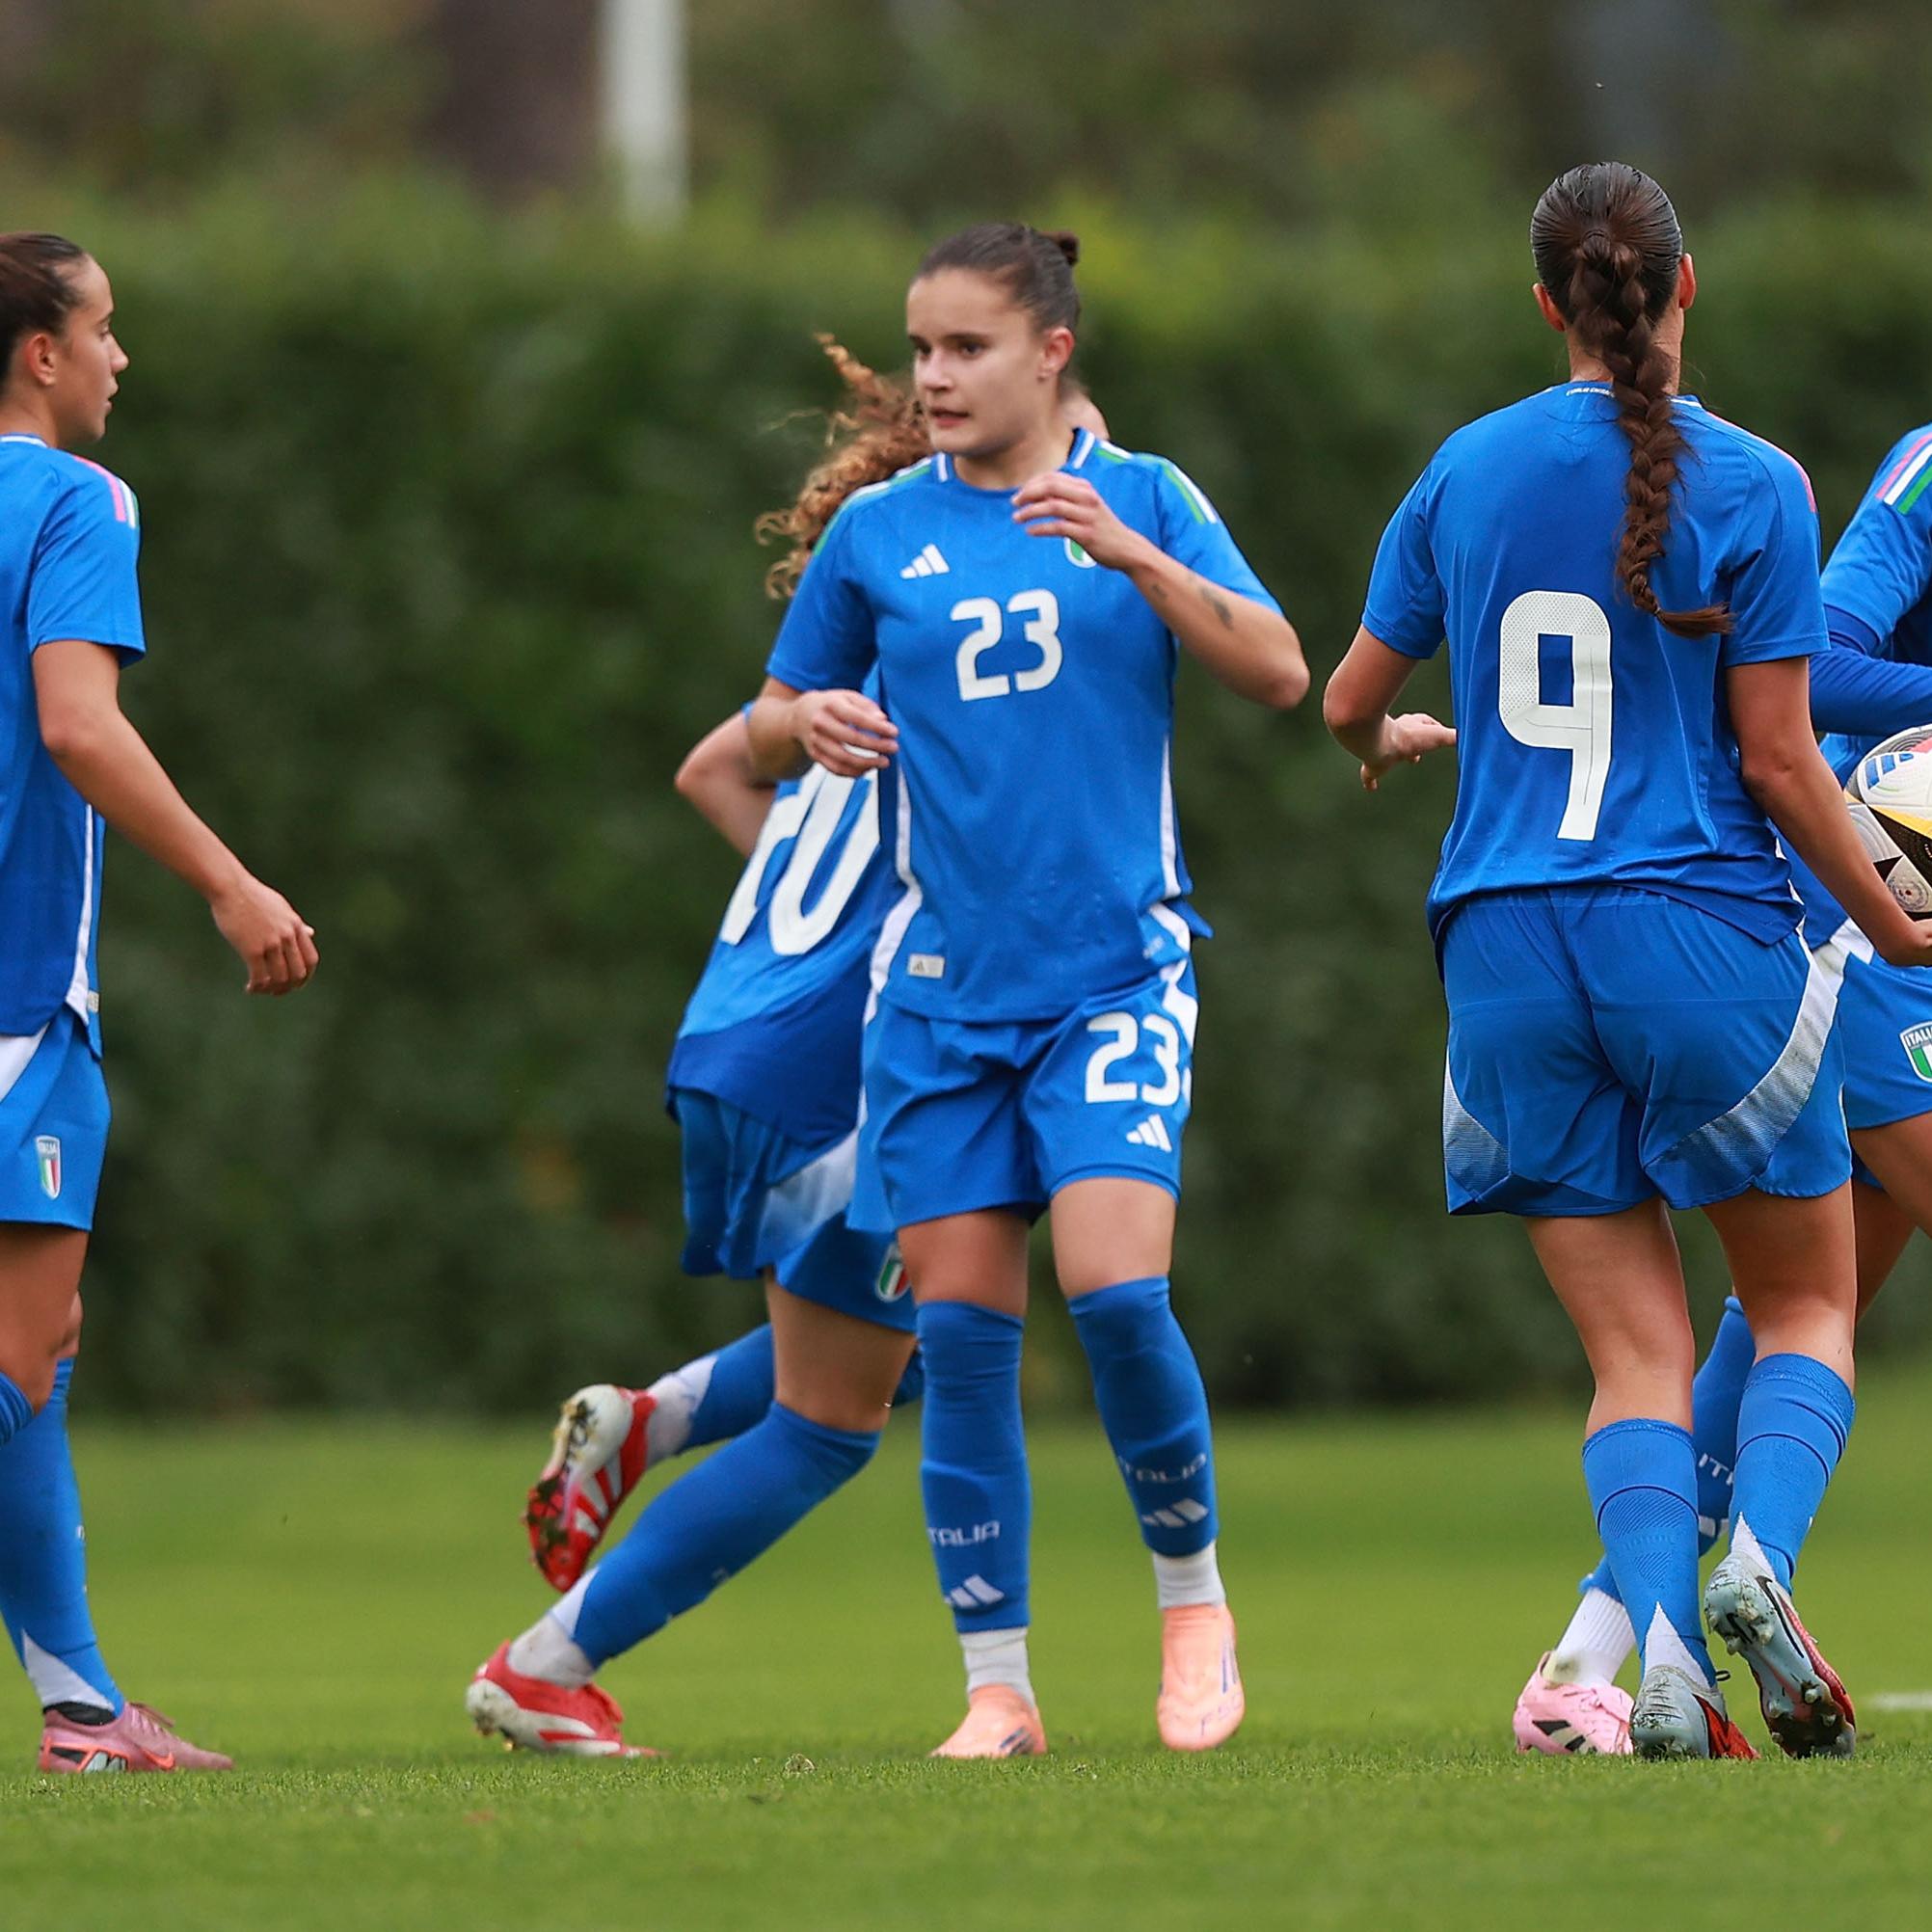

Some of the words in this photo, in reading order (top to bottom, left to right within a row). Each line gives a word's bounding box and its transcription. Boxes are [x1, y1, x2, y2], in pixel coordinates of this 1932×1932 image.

[950, 589, 1062, 701] 23
[1498, 590, 1613, 841] 9
[1085, 1011, 1180, 1106] 23
[1905, 1026, 1932, 1047] ITALI
